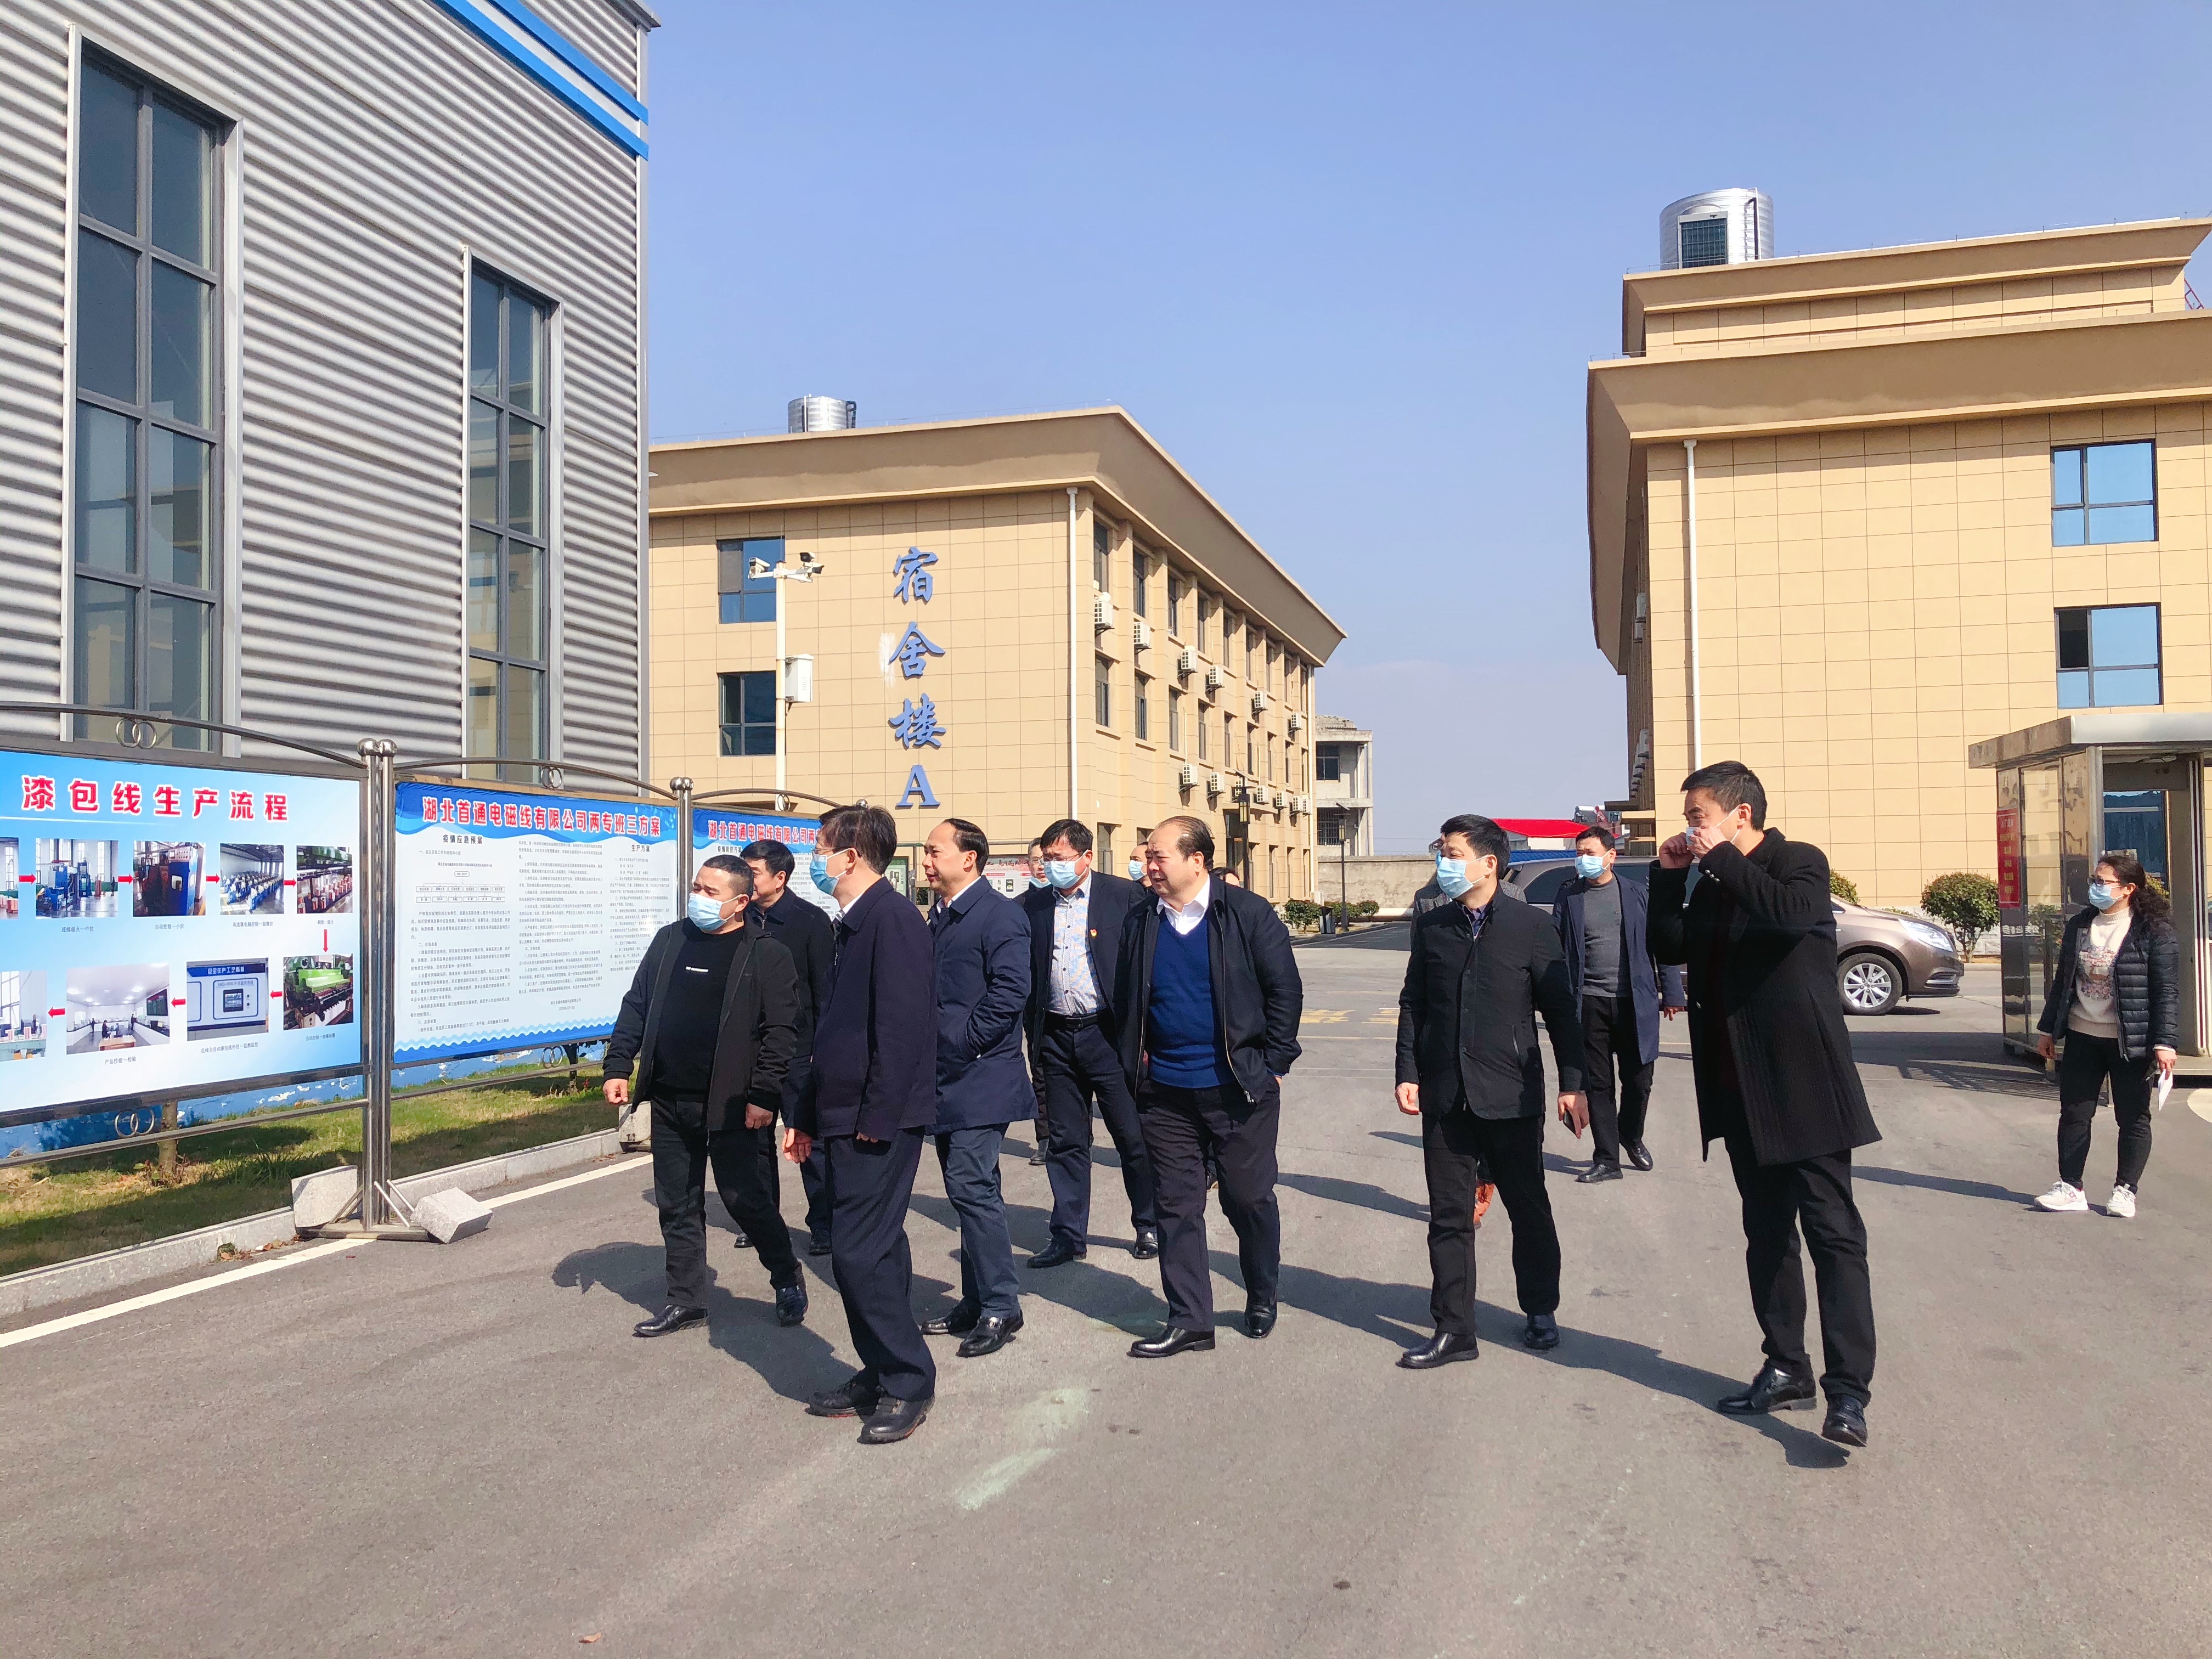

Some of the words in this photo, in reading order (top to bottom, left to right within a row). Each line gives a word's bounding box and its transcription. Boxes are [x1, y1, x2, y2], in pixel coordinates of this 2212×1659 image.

[22, 775, 289, 821] 漆包线生产流程
[422, 796, 661, 836] 湖北首通电磁线有限公司两专班三方案
[443, 834, 483, 844] 疫情应急预案
[708, 820, 820, 845] 湖北首通电磁线有限公司两
